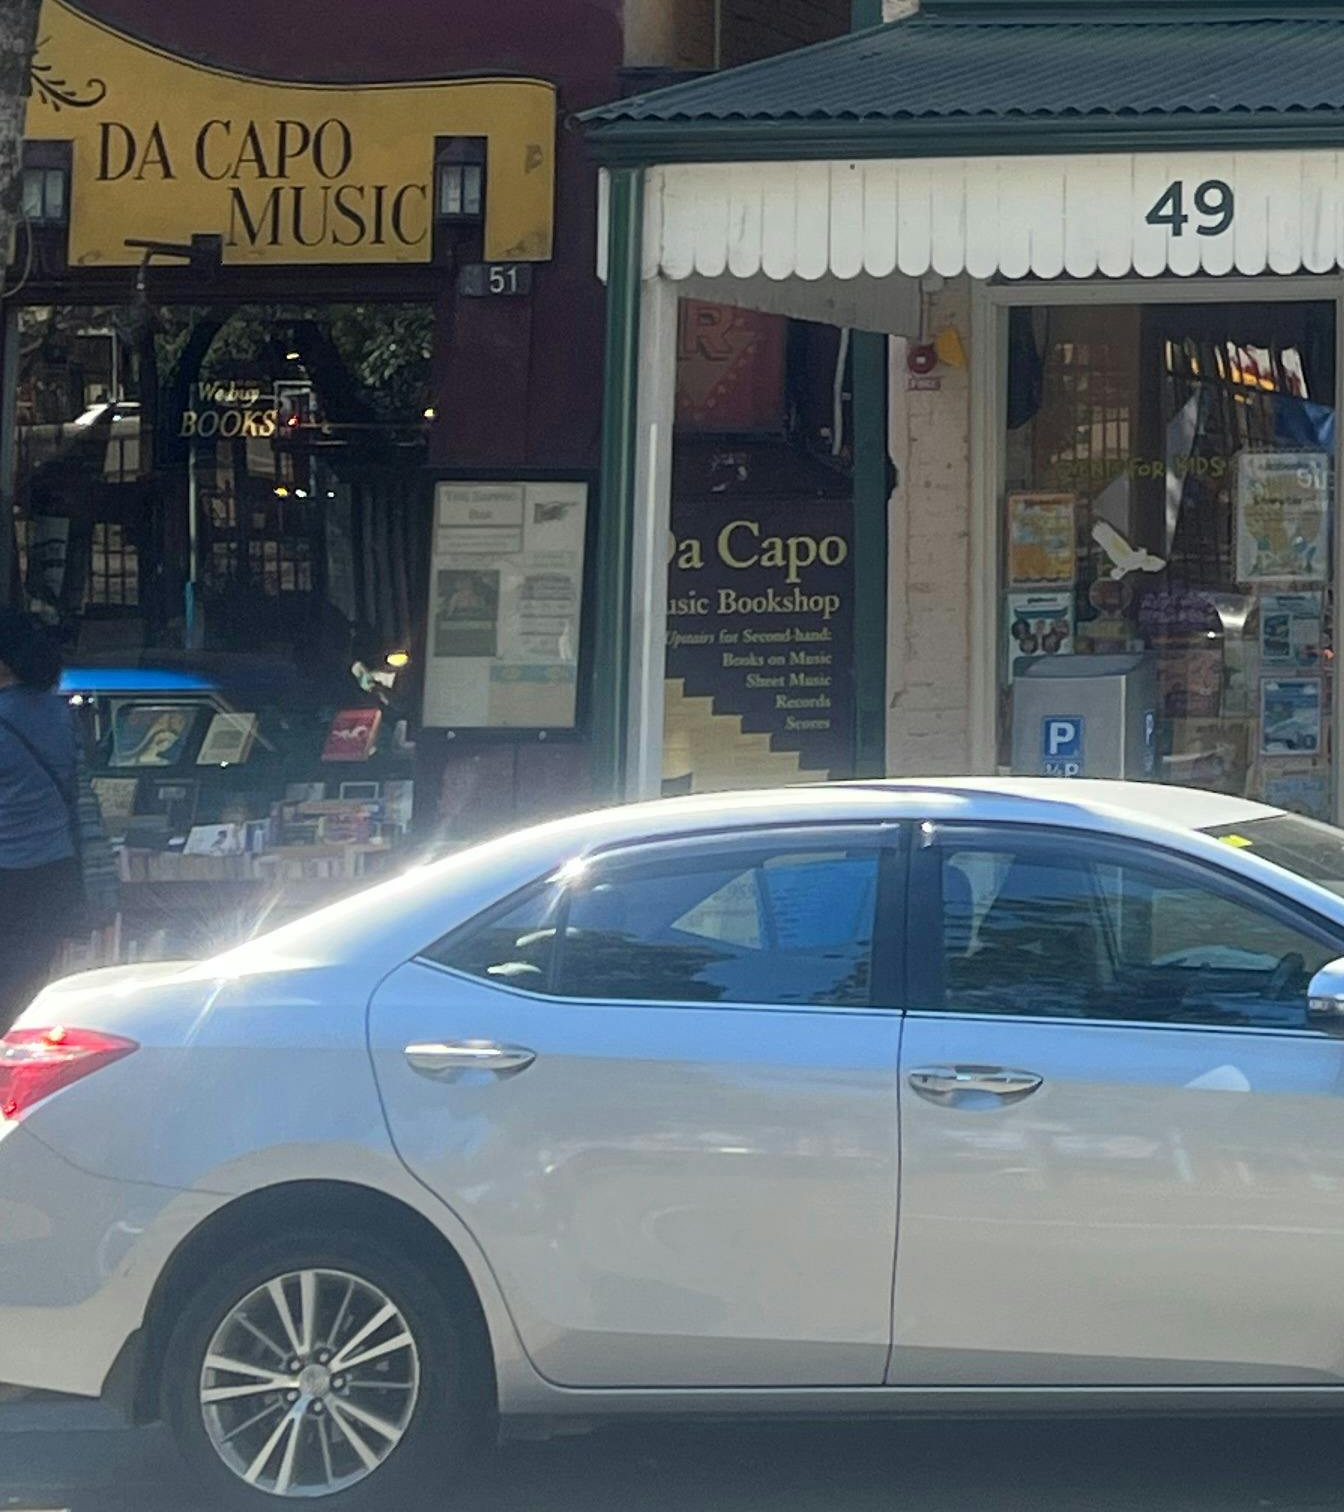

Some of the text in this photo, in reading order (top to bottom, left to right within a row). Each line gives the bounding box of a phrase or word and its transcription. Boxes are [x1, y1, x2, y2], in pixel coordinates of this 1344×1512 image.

[95, 118, 353, 181] DA CAPO
[225, 184, 431, 246] MUSIC
[1145, 179, 1236, 239] 49
[489, 266, 519, 293] 51
[180, 409, 278, 438] BOOKS
[717, 520, 848, 584] Capo
[717, 587, 840, 620] Bookshop
[722, 651, 832, 667] Books on Music
[746, 672, 832, 688] Sheet Music
[776, 694, 832, 709] Records
[784, 716, 831, 730] Scores
[1049, 721, 1076, 755] P
